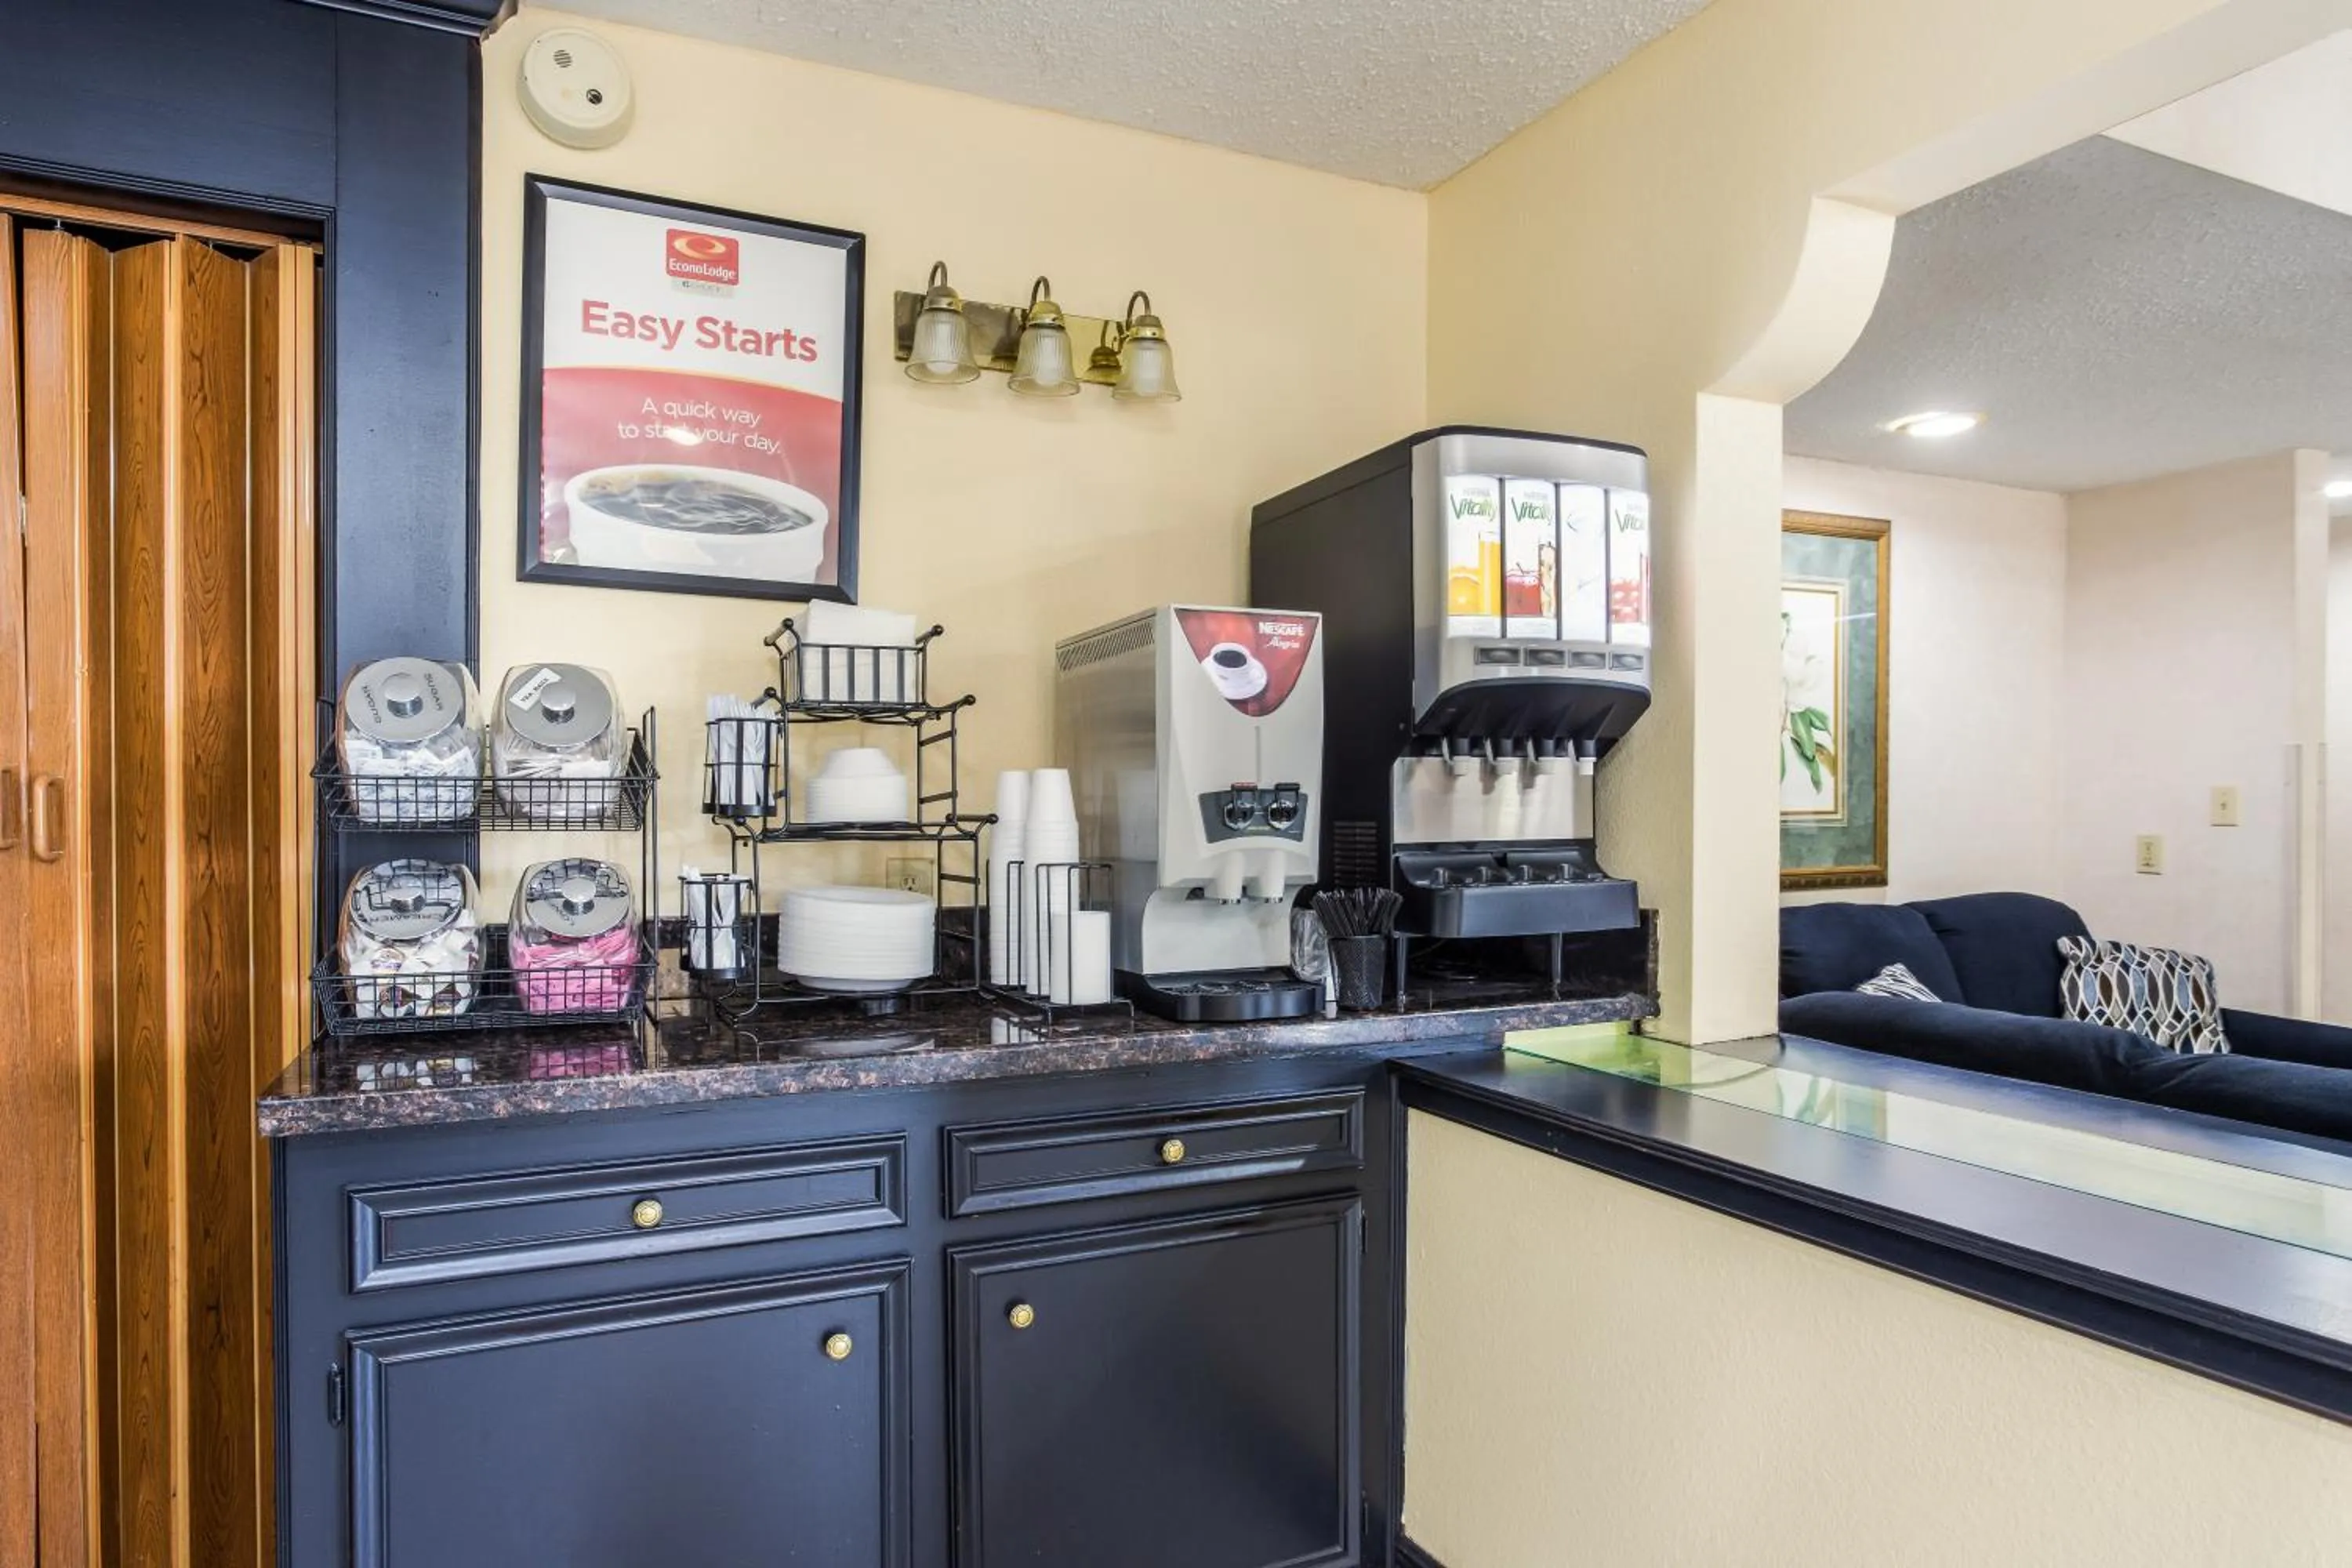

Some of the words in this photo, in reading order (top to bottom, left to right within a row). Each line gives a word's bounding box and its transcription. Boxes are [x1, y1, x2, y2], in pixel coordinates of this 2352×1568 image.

[583, 299, 684, 351] Easy
[695, 316, 818, 361] Starts
[641, 397, 659, 415] A
[664, 401, 717, 419] quick
[722, 407, 761, 428] way
[618, 420, 640, 439] to
[645, 421, 693, 442] sta
[695, 426, 740, 445] your
[744, 434, 782, 455] day.
